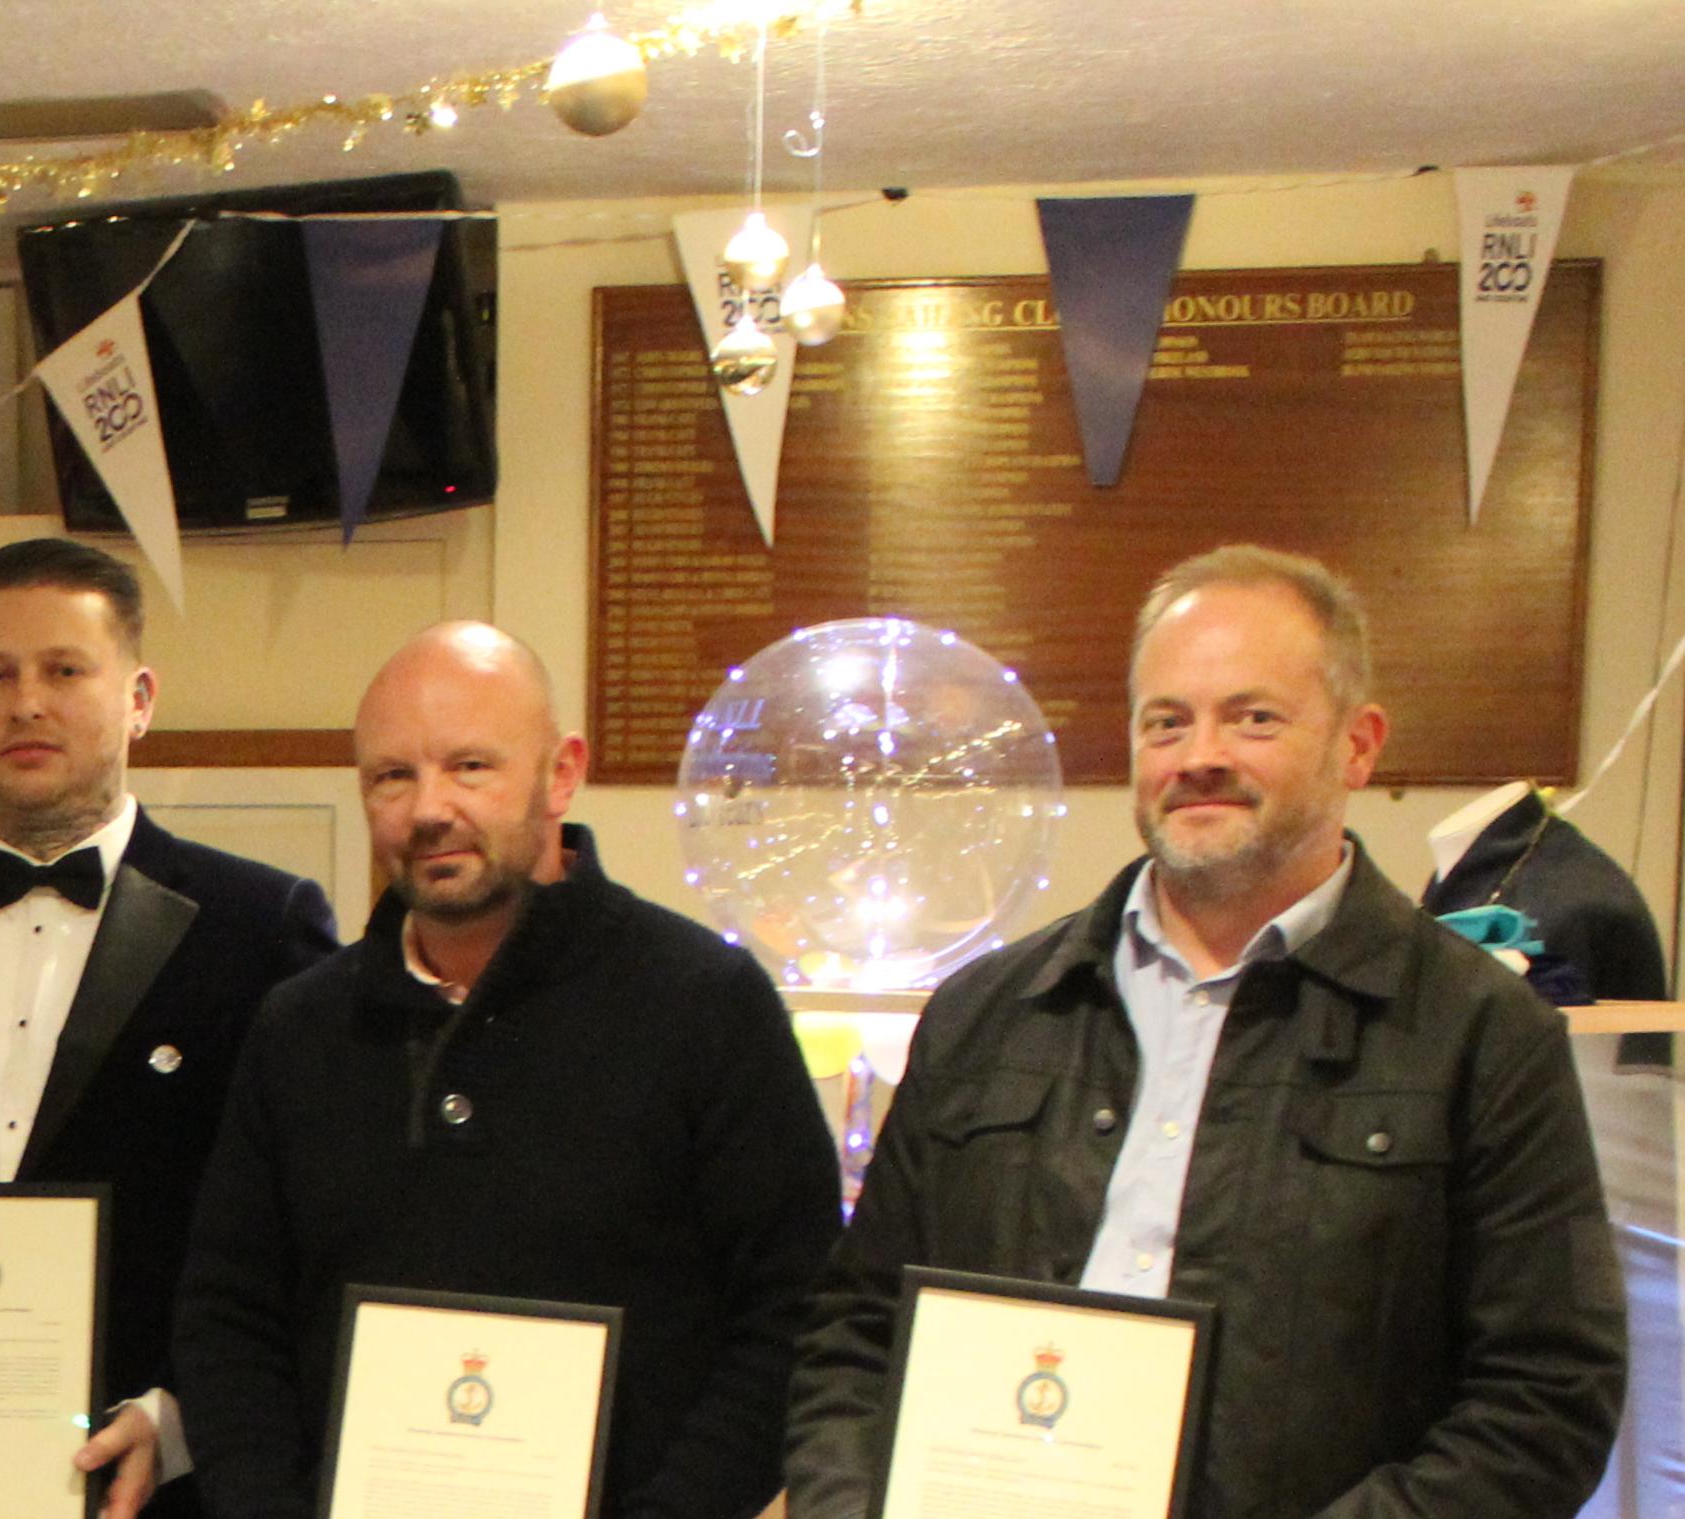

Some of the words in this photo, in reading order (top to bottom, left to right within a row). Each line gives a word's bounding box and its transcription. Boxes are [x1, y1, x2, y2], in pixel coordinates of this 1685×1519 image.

[1481, 232, 1537, 259] RNLI
[1478, 262, 1533, 292] 200
[1014, 300, 1059, 326] CL
[1305, 290, 1414, 318] BOARD
[94, 392, 144, 442] 200
